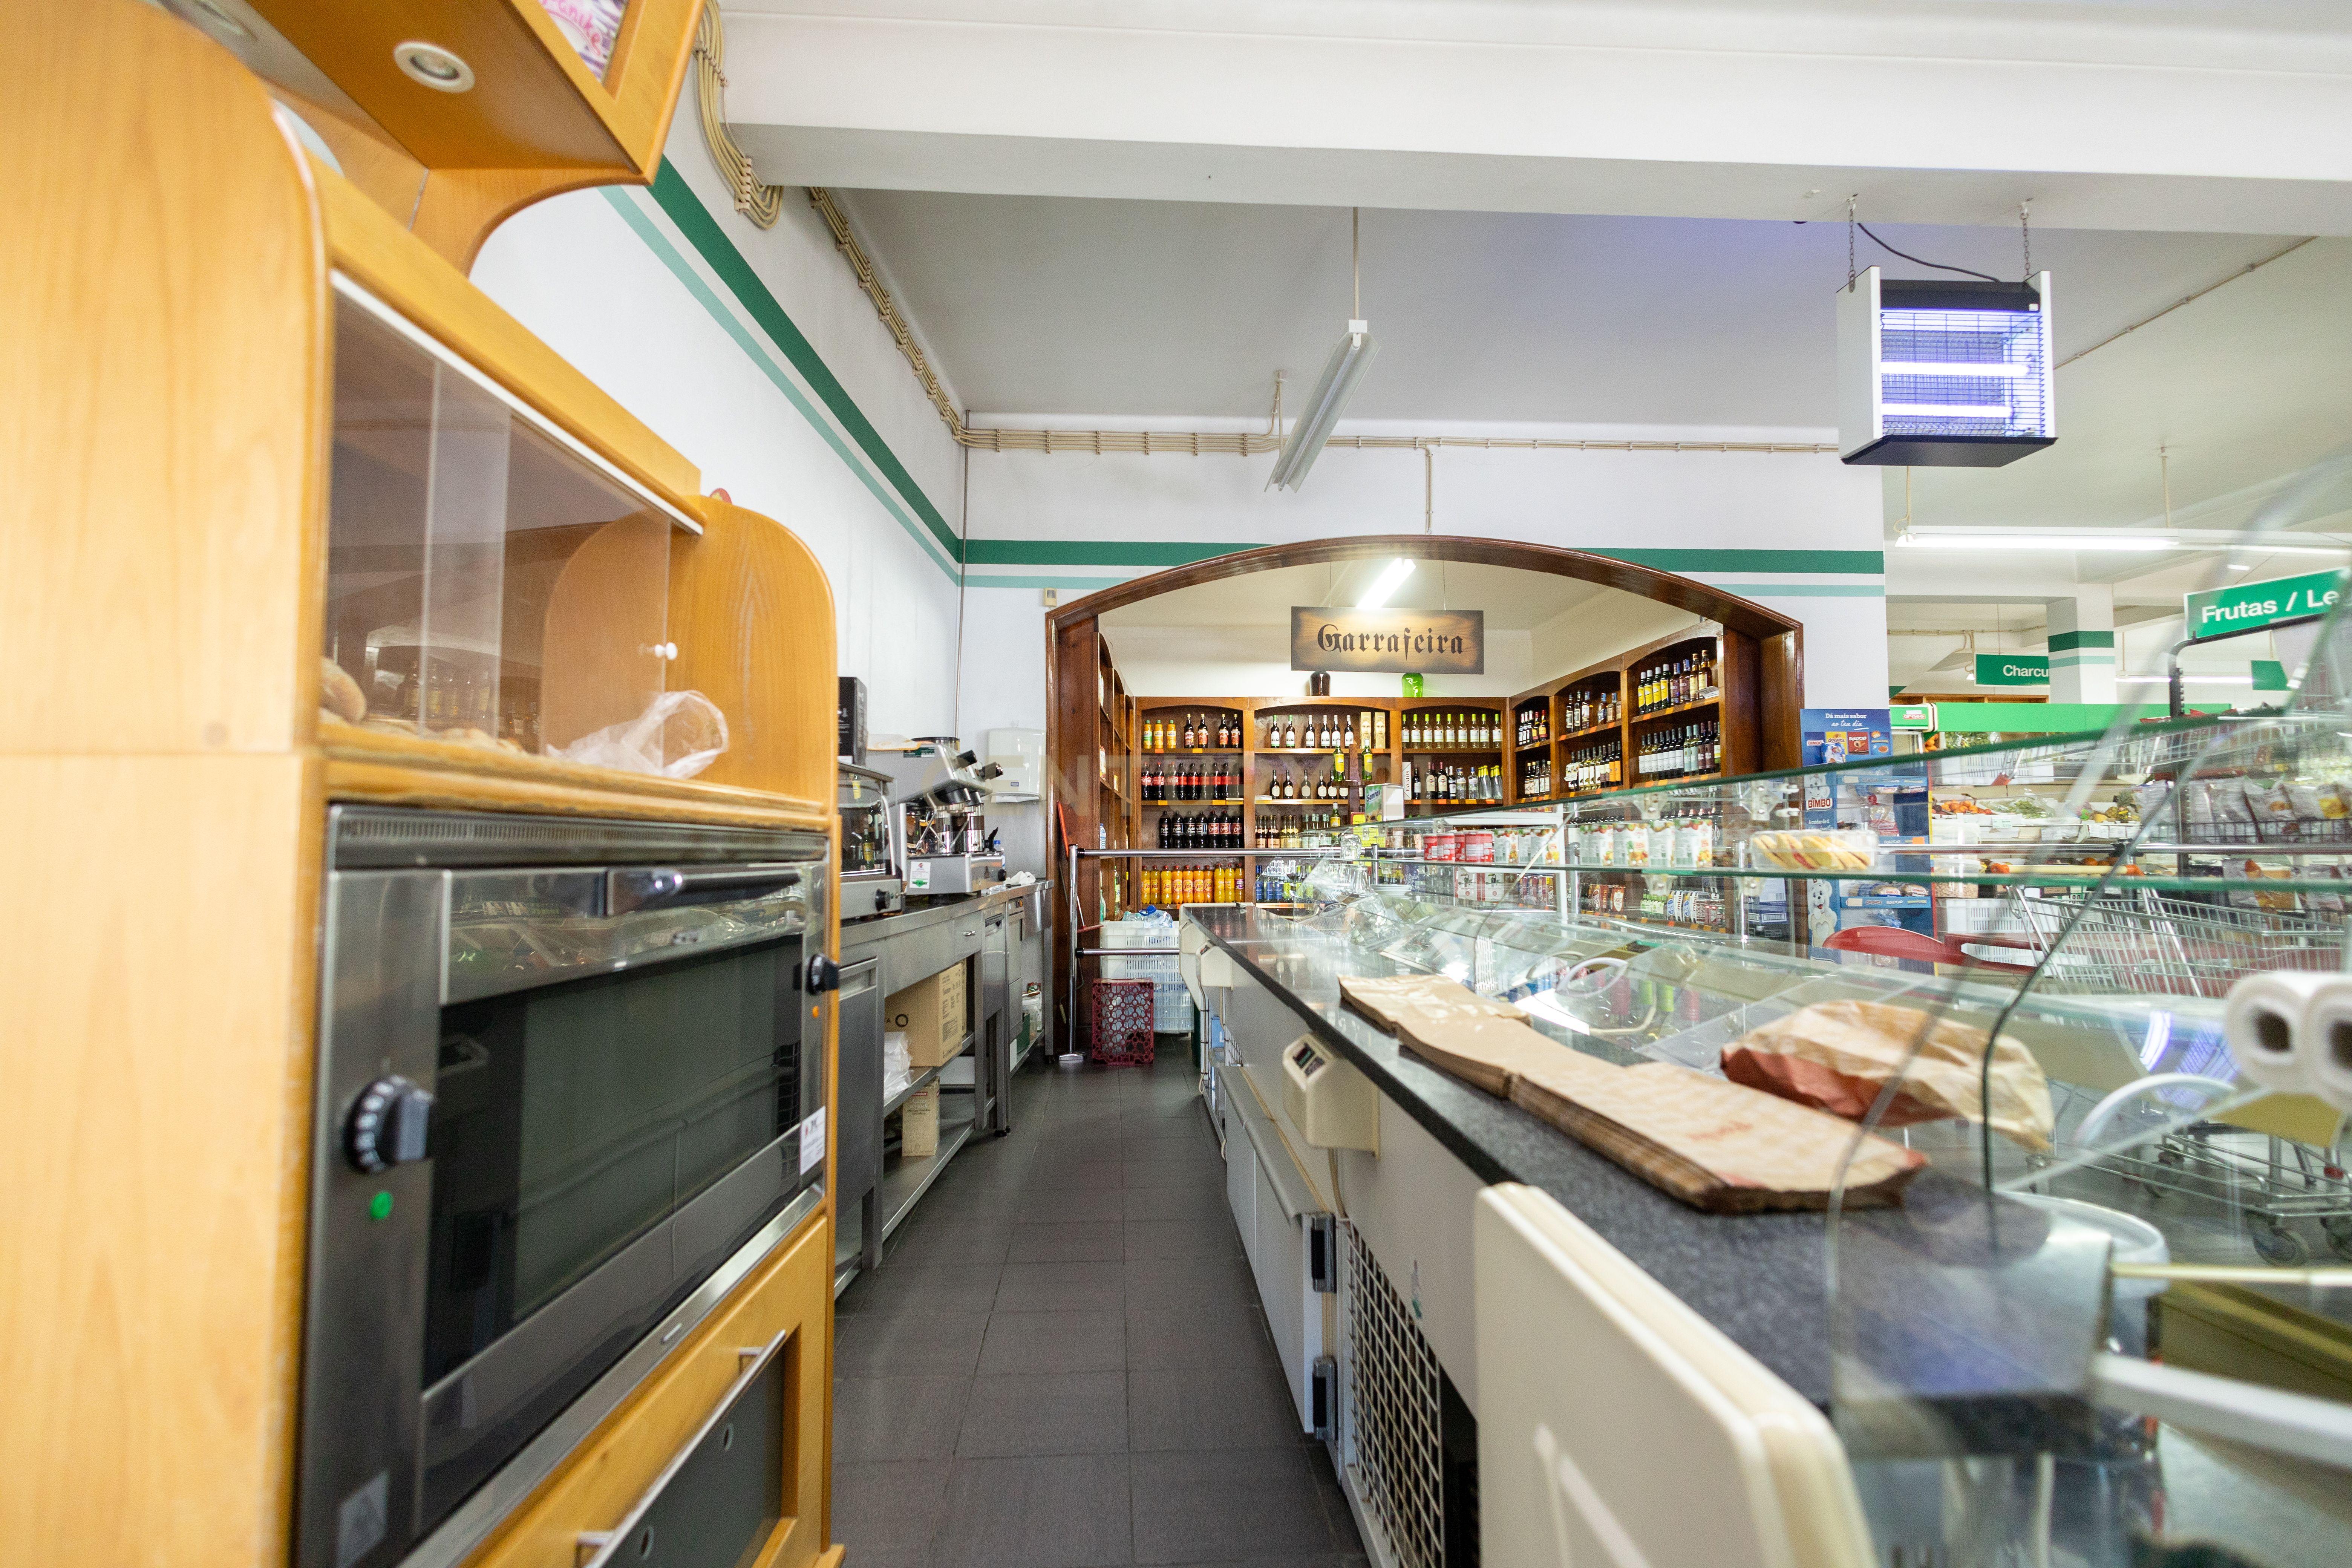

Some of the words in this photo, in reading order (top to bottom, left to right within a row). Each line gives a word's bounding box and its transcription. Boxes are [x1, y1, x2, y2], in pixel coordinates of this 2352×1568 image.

[2201, 599, 2277, 624] Frutas
[1317, 624, 1463, 660] Garrafeira
[1808, 799, 1830, 808] BIMBO
